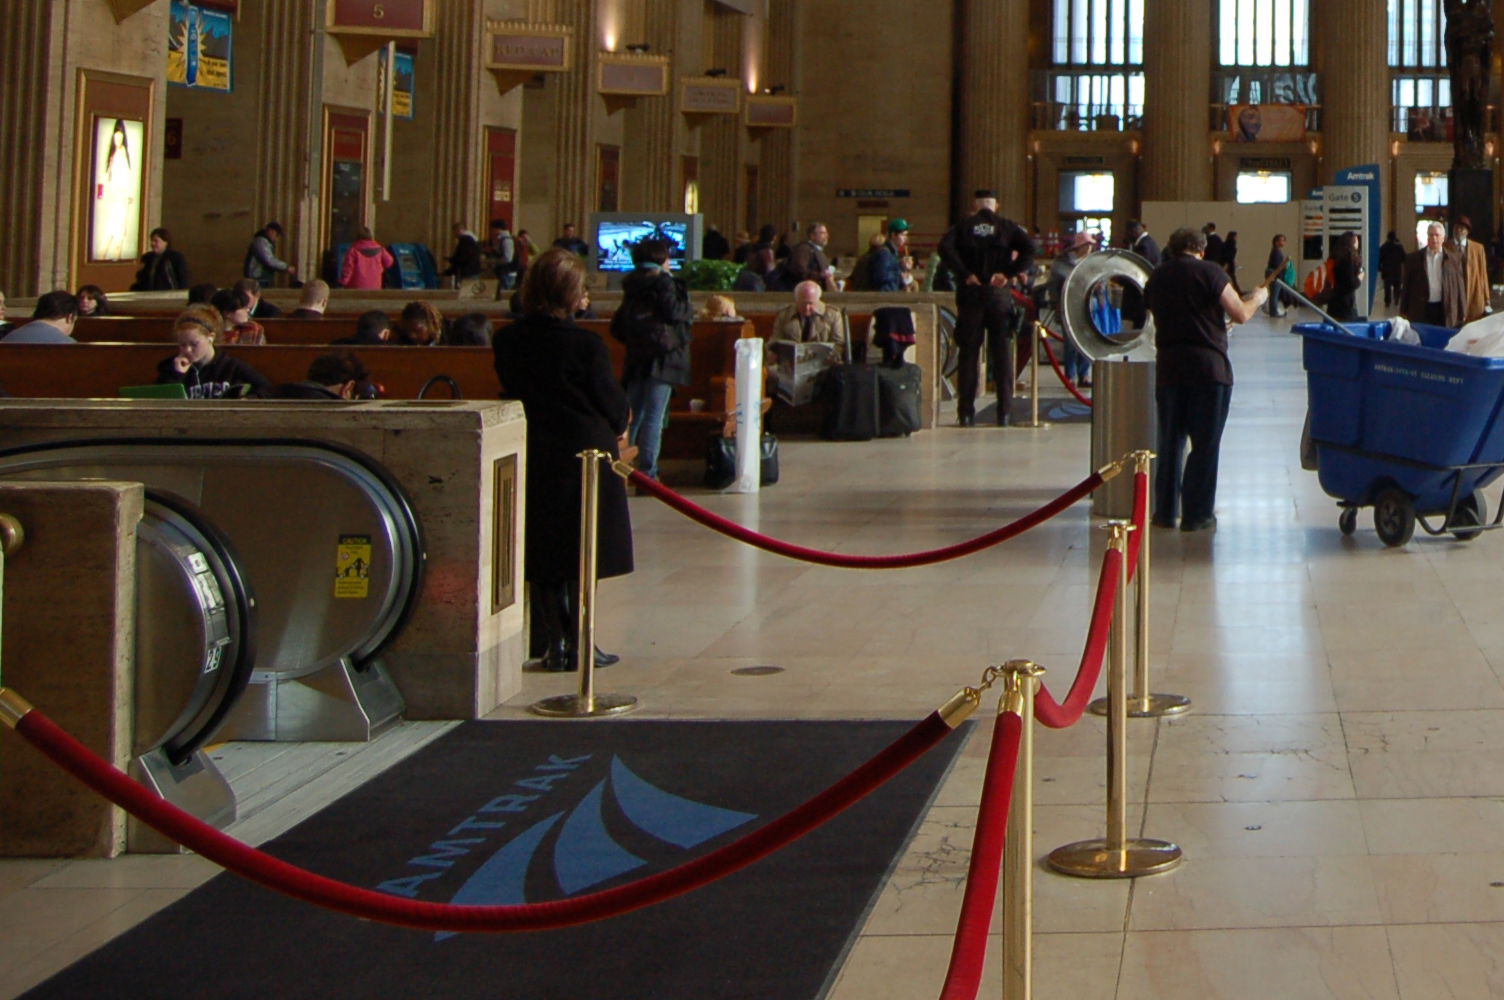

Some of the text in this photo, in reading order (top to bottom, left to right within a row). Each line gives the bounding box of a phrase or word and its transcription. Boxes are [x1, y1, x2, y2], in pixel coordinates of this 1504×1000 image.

[373, 4, 385, 19] 5
[1347, 171, 1375, 180] Amtrak
[1328, 192, 1349, 202] Gate
[376, 753, 592, 898] AMTRAK
